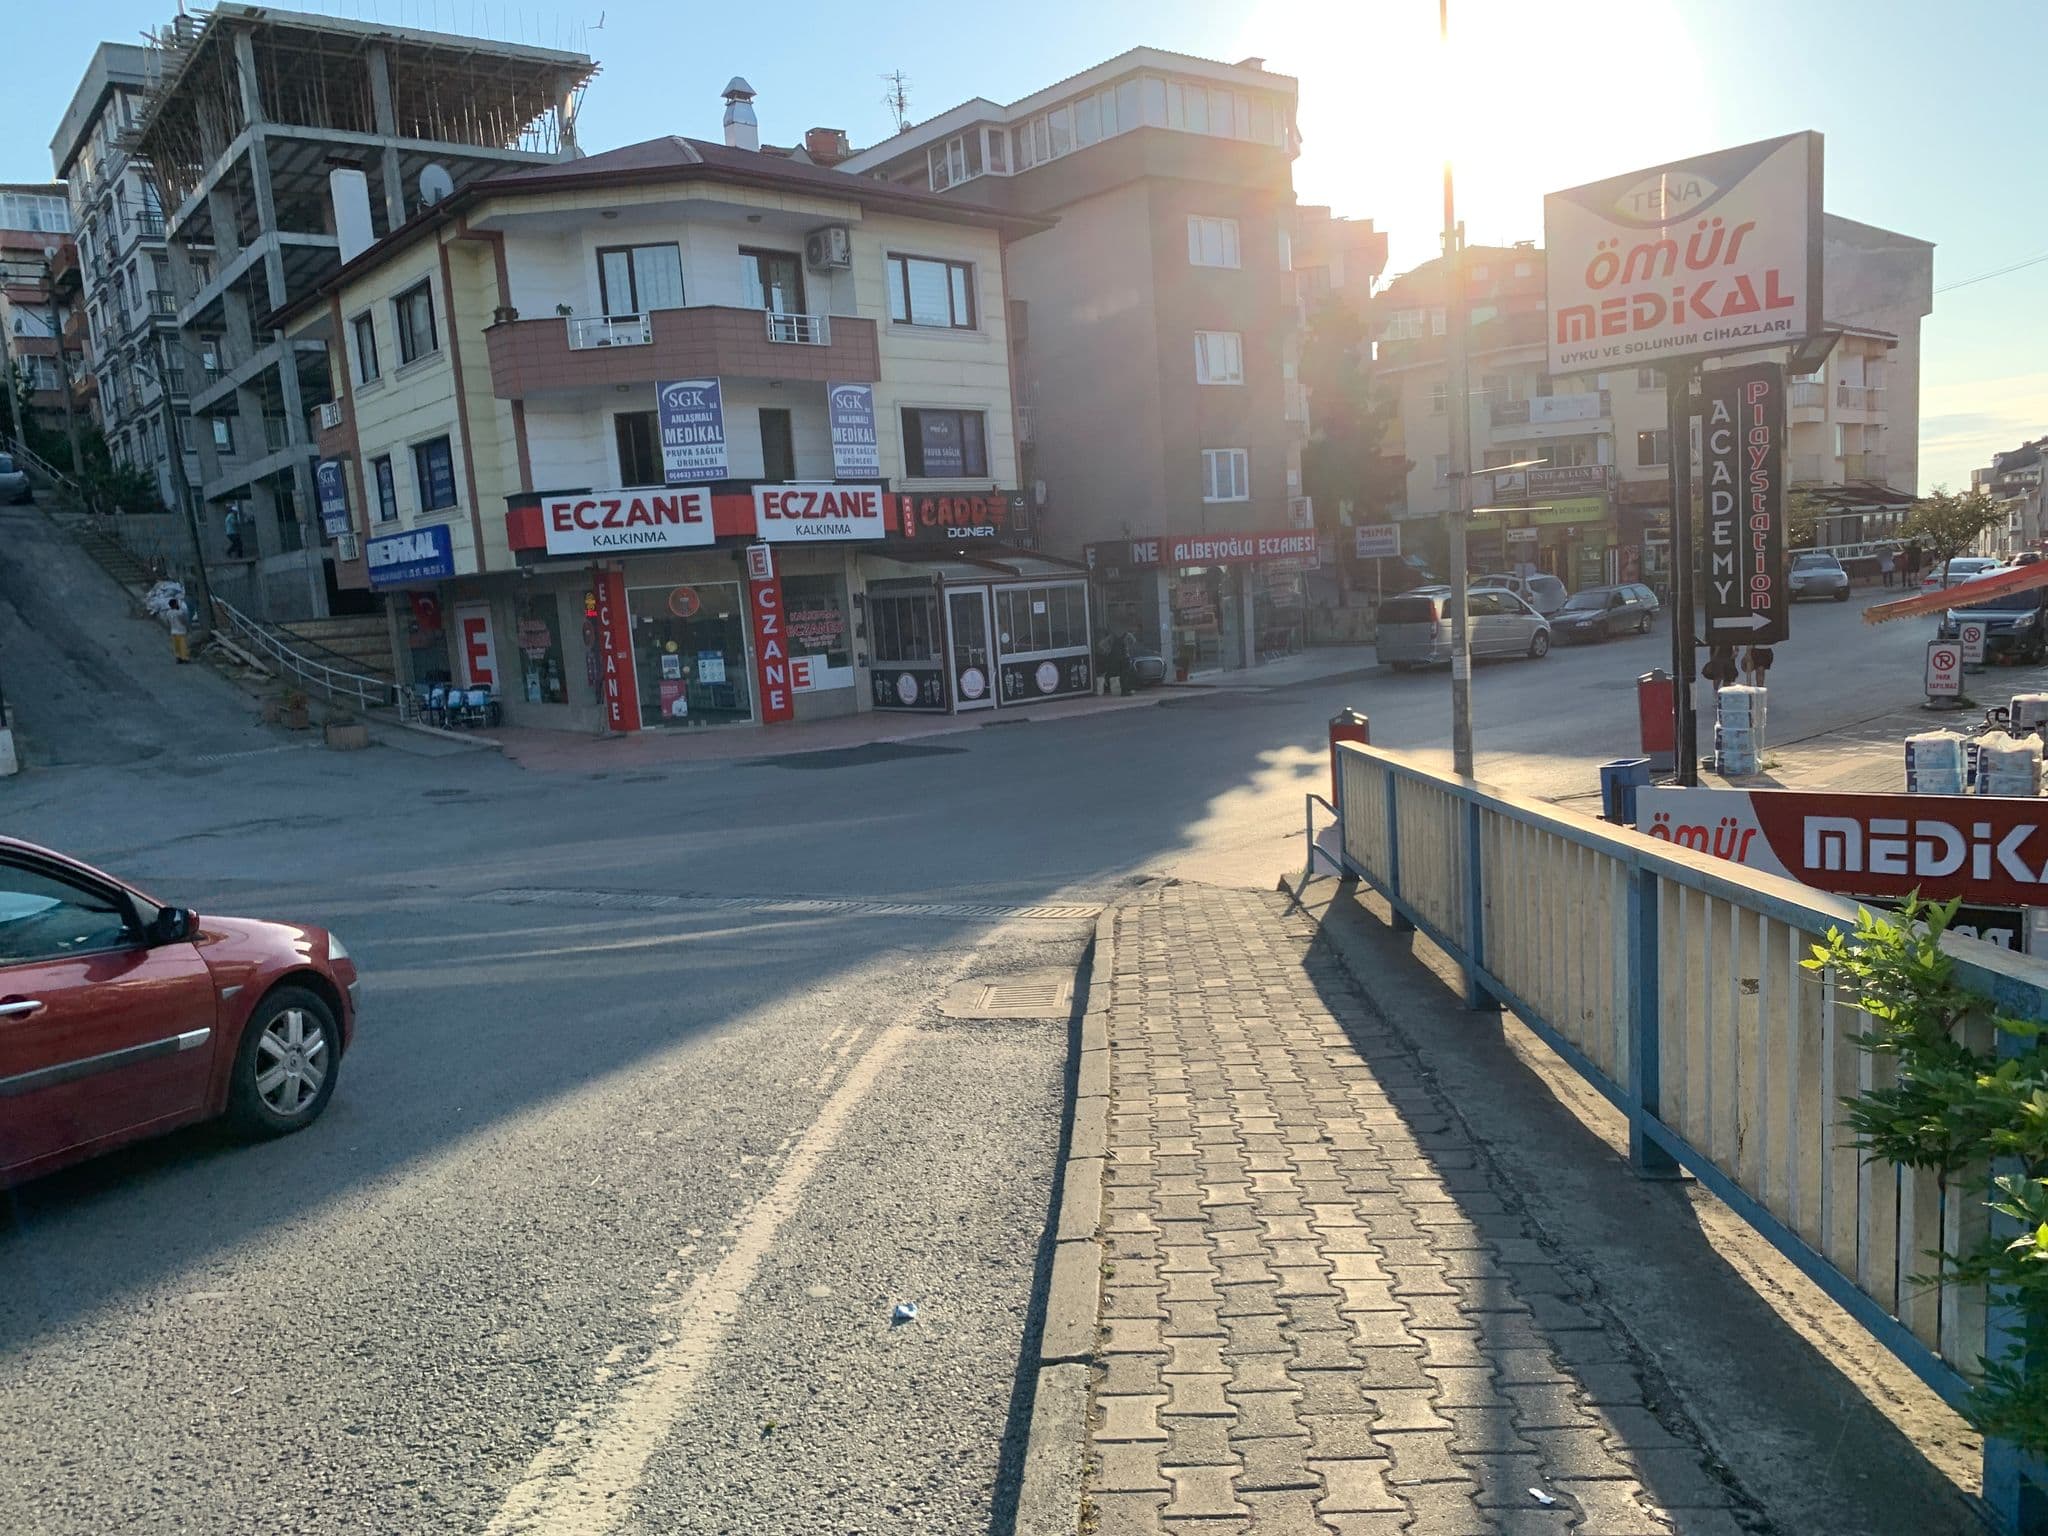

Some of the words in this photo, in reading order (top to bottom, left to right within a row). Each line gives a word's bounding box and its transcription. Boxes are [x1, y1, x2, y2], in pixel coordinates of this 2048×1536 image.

[1630, 180, 1703, 213] TENA
[1561, 348, 1601, 365] UYKU
[1603, 347, 1620, 358] VE
[1624, 333, 1698, 355] SOLUNUM
[1703, 319, 1792, 342] CİHAZLARI
[668, 391, 705, 408] SGK
[836, 394, 863, 409] SGK
[664, 423, 723, 444] MEDİKAL
[833, 424, 875, 443] MEDİKAL
[666, 448, 693, 457] PRUVA
[552, 494, 703, 532] ECZANE
[762, 491, 878, 519] ECZANE
[1710, 400, 1733, 606] ACADEMY
[592, 531, 667, 547] KALKINMA
[795, 524, 851, 536] KALKINMA
[1174, 538, 1253, 561] ALİBEYOĞLU
[1258, 535, 1315, 555] ECZANESİ
[599, 584, 620, 721] ECZANE
[791, 662, 811, 688] E
